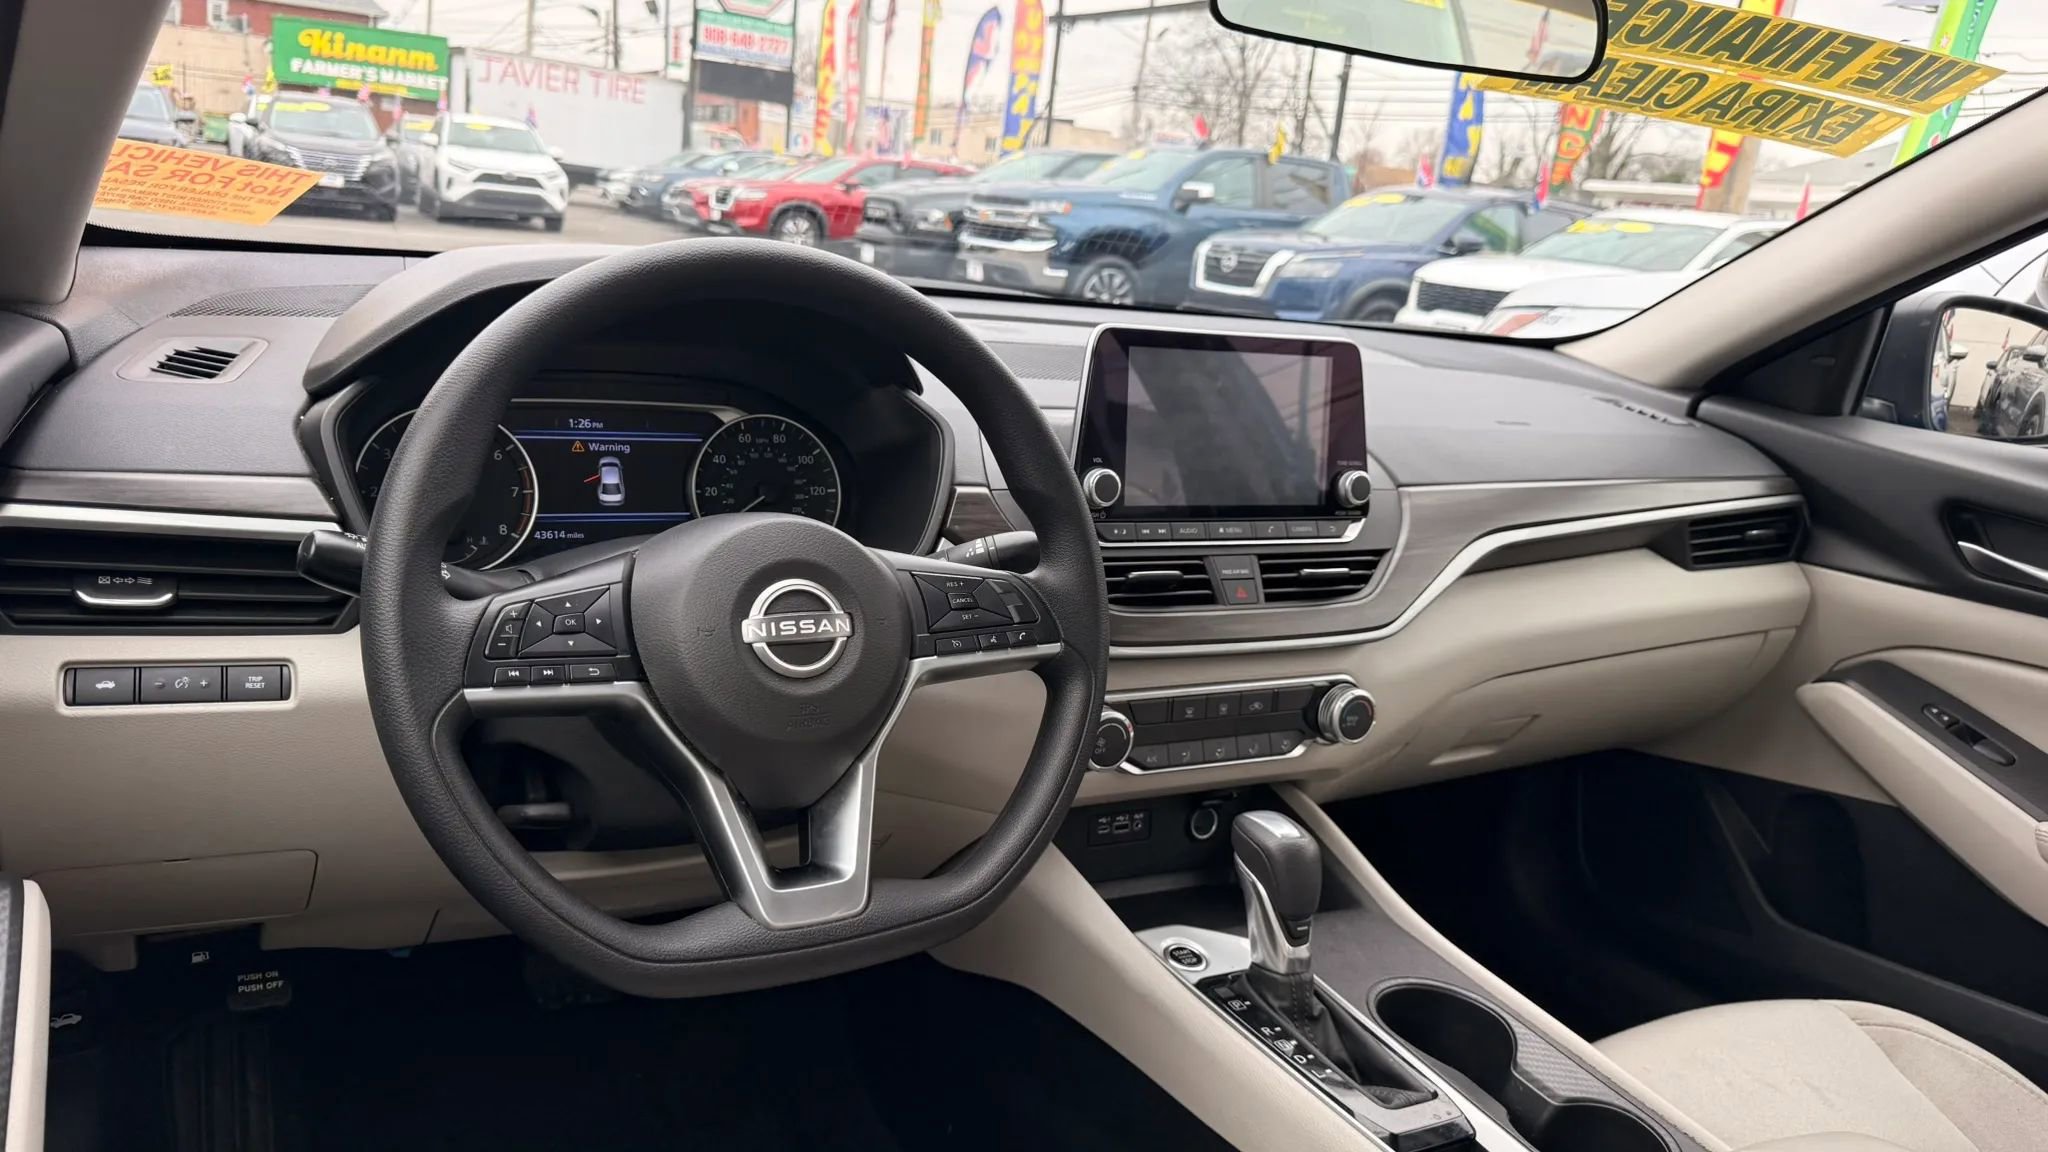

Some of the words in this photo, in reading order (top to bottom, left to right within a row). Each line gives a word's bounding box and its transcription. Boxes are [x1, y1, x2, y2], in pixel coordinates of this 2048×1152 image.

[290, 57, 378, 82] FARMER'S
[380, 69, 449, 91] MARKET
[473, 54, 580, 95] JAVIER
[589, 69, 647, 105] TIRE
[738, 433, 752, 444] 60
[773, 433, 786, 444] 80
[588, 442, 631, 454] Warning
[494, 449, 503, 461] 6
[712, 454, 727, 464] 40
[798, 455, 814, 465] 100
[511, 486, 519, 497] 7
[704, 486, 718, 497] 20
[810, 486, 826, 496] 120
[498, 524, 508, 536] 8
[534, 530, 566, 540] 43614
[566, 530, 585, 539] miles
[748, 618, 851, 639] NISSAN
[237, 972, 263, 983] PUSH
[264, 970, 279, 979] ON
[238, 983, 264, 993] PUSH
[265, 980, 284, 990] OFF
[1261, 1027, 1275, 1036] R
[1293, 1055, 1307, 1065] D
[1311, 1069, 1327, 1079] L
